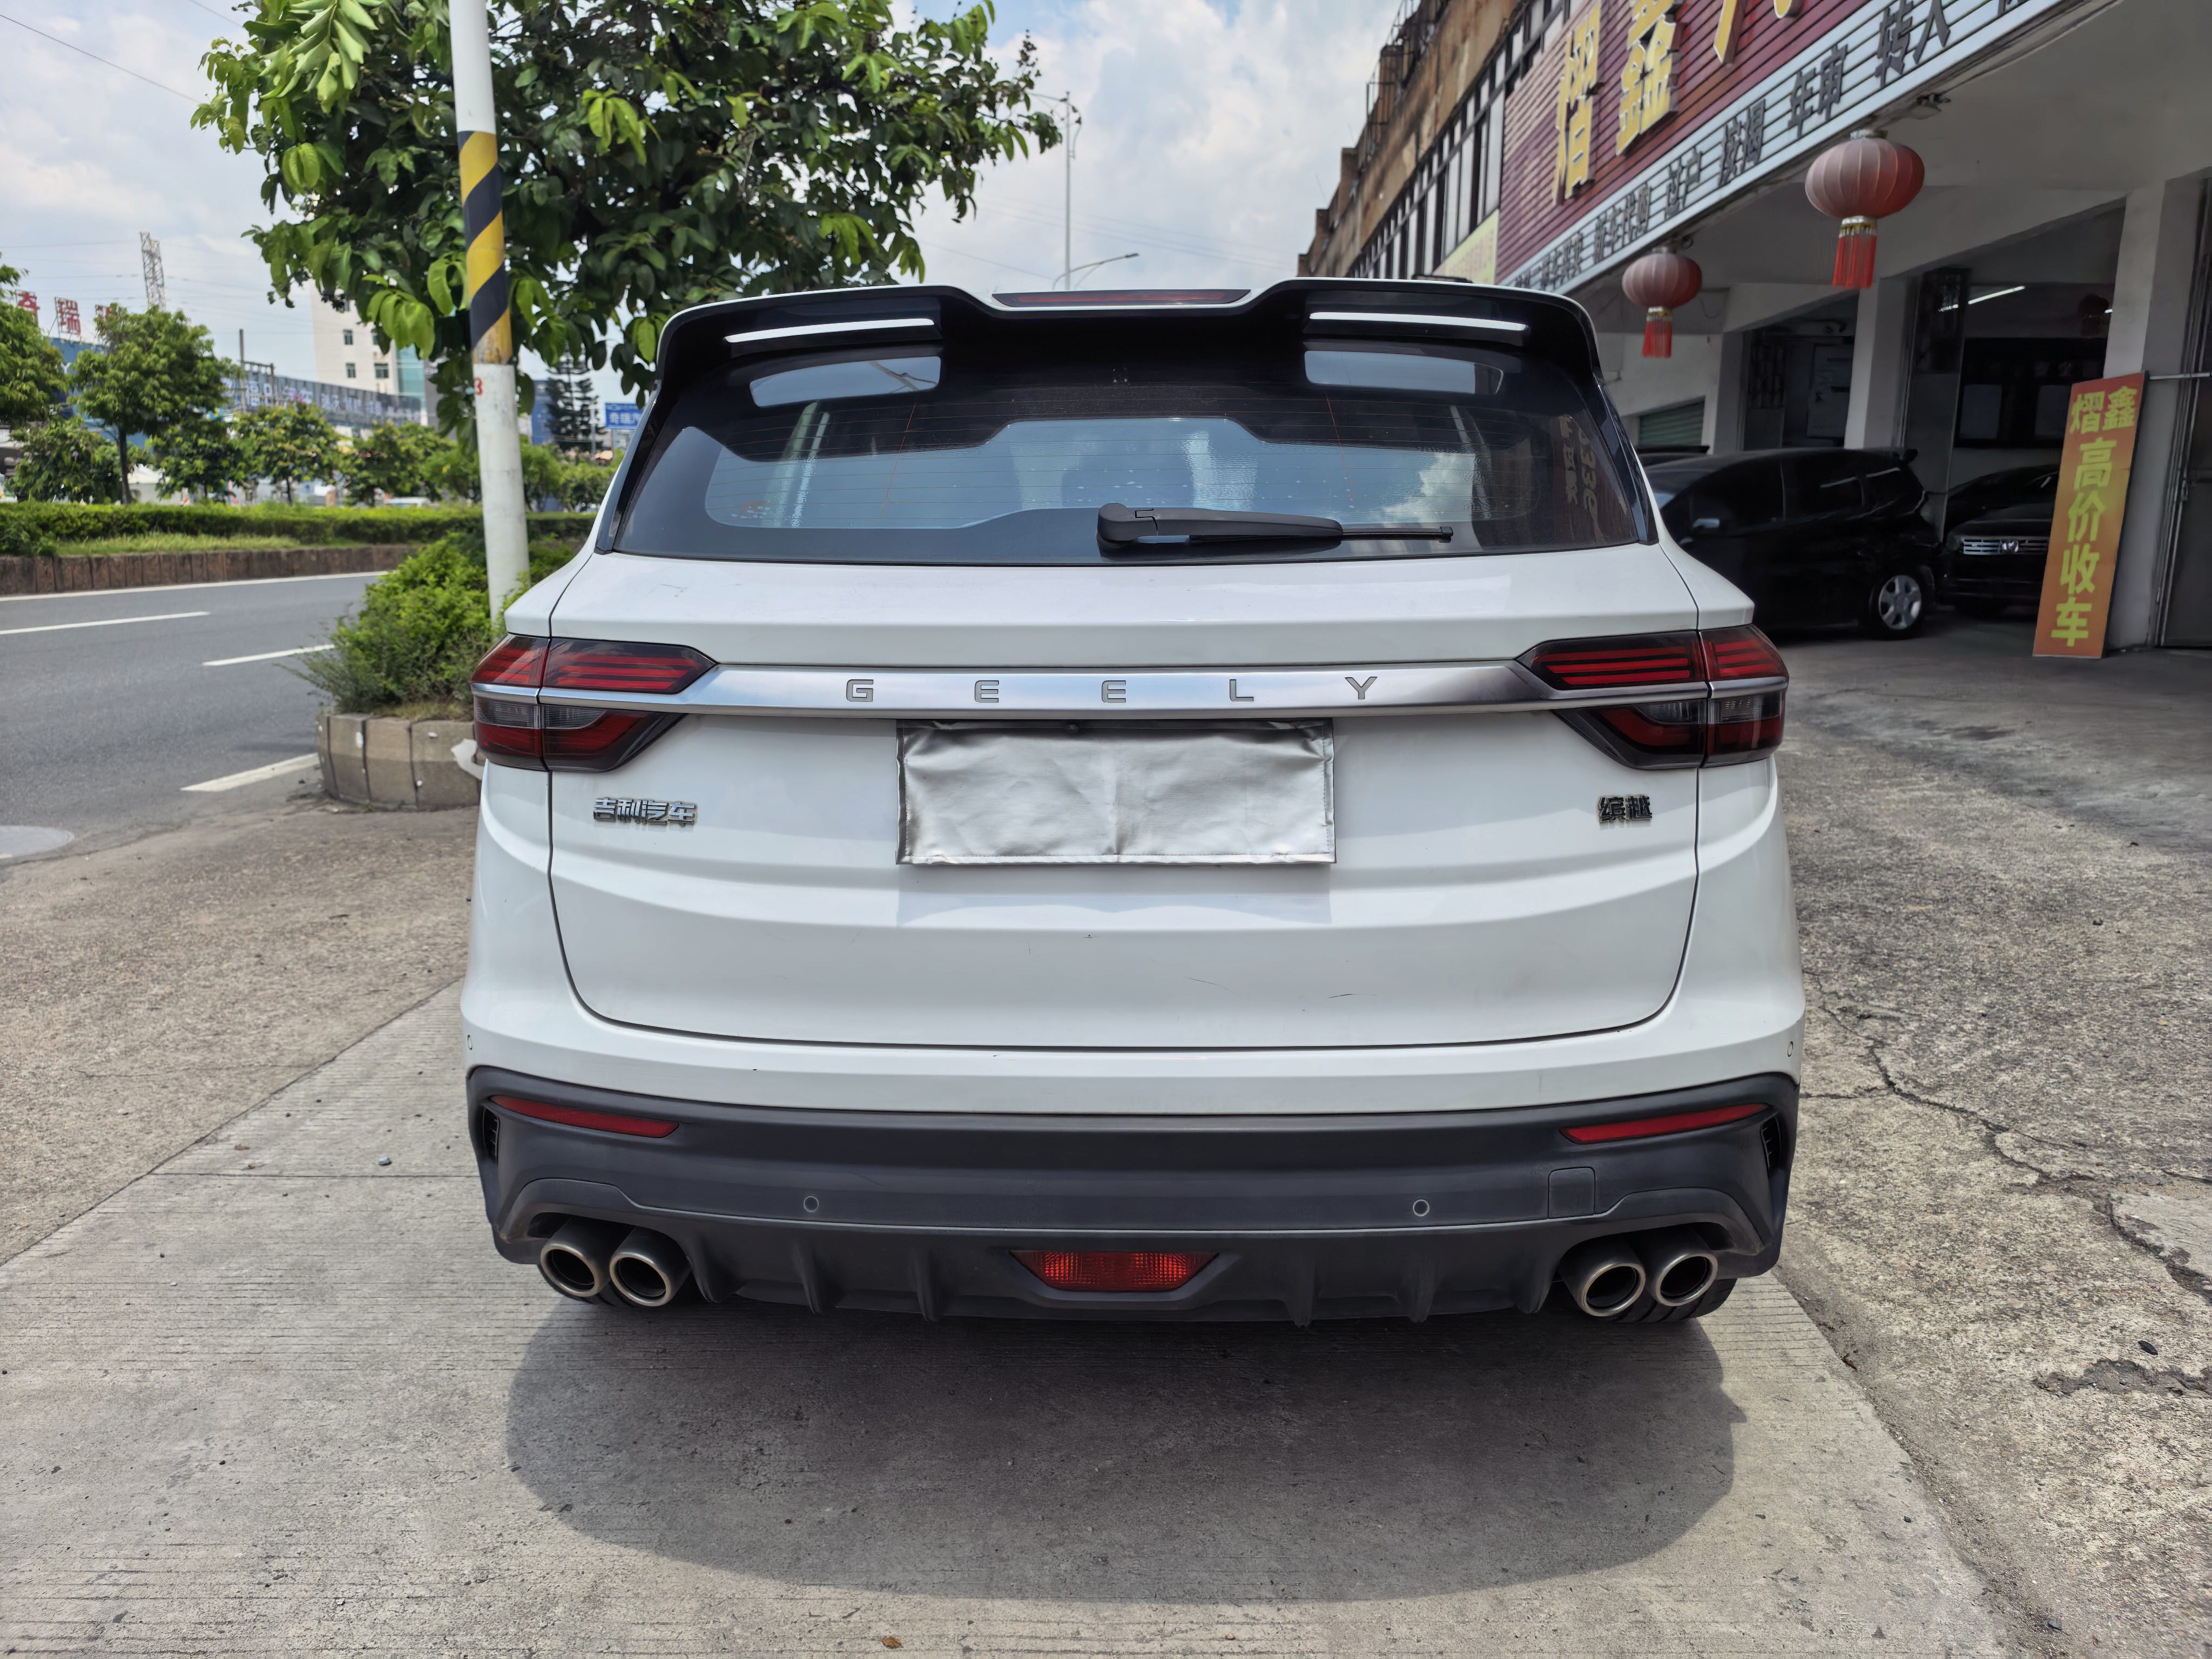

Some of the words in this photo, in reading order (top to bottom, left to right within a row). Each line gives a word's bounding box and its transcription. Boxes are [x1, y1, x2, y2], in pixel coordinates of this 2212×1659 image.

[1718, 99, 1766, 187] 按揭
[1788, 44, 1849, 138] 年审
[2069, 386, 2138, 434] 熠鑫
[2051, 437, 2117, 646] 高价收车
[846, 676, 1378, 703] GEELY
[594, 798, 697, 826] 吉利汽车
[1599, 795, 1653, 823] 缤越
